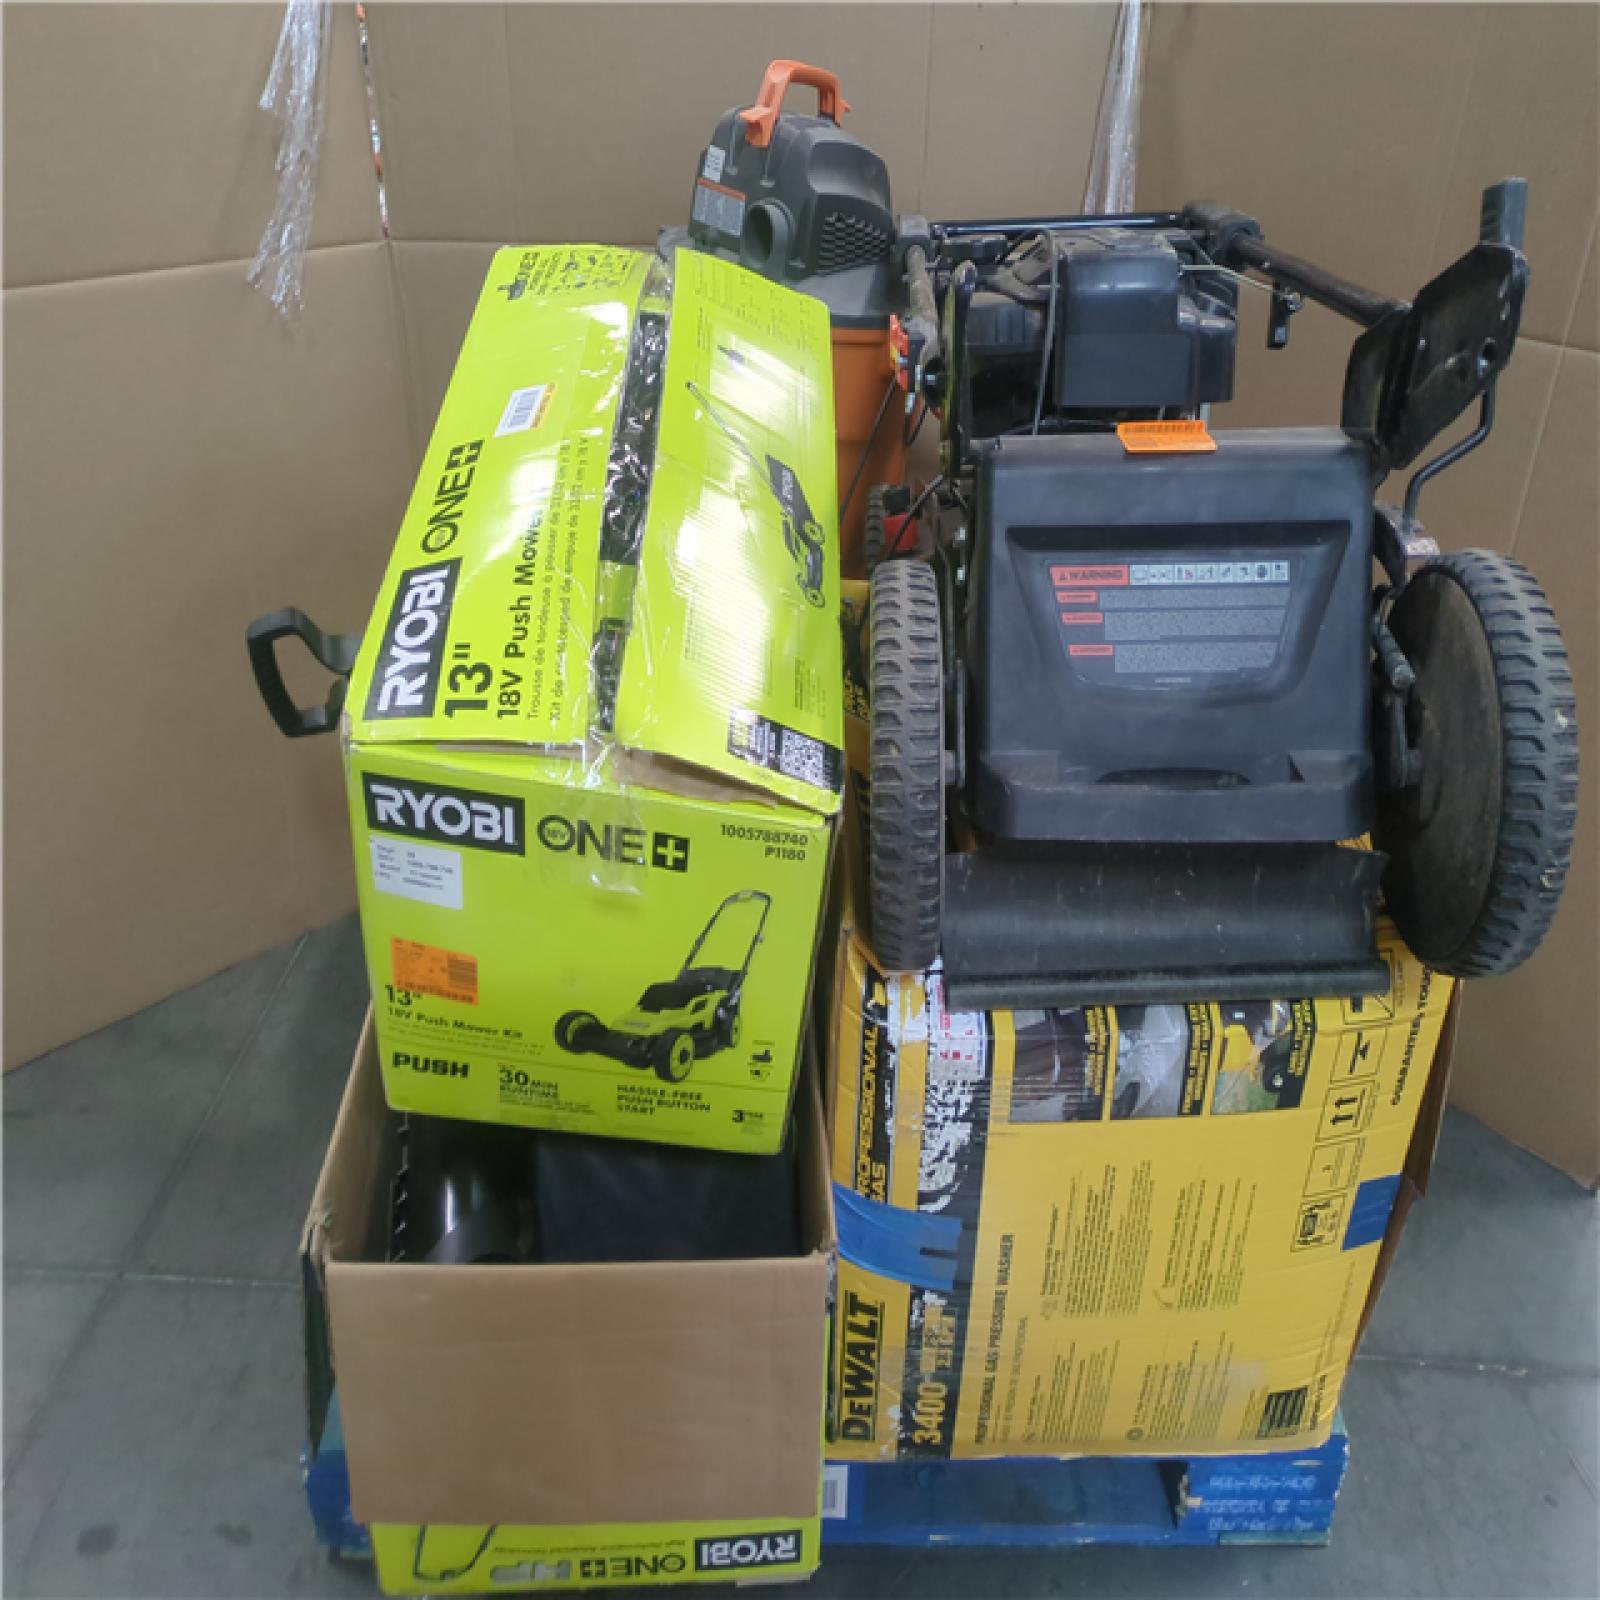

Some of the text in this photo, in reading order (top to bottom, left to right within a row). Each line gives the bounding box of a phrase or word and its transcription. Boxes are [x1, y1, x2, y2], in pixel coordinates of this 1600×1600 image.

[378, 569, 448, 711] RYOBI
[504, 595, 534, 659] Push
[444, 641, 494, 718] 13"
[497, 670, 523, 720] 18V
[369, 783, 518, 846] RYOBI
[392, 1051, 470, 1079] PUSH
[499, 1069, 529, 1087] 30
[911, 1381, 948, 1445] 3400
[701, 1534, 798, 1568] RYOBI
